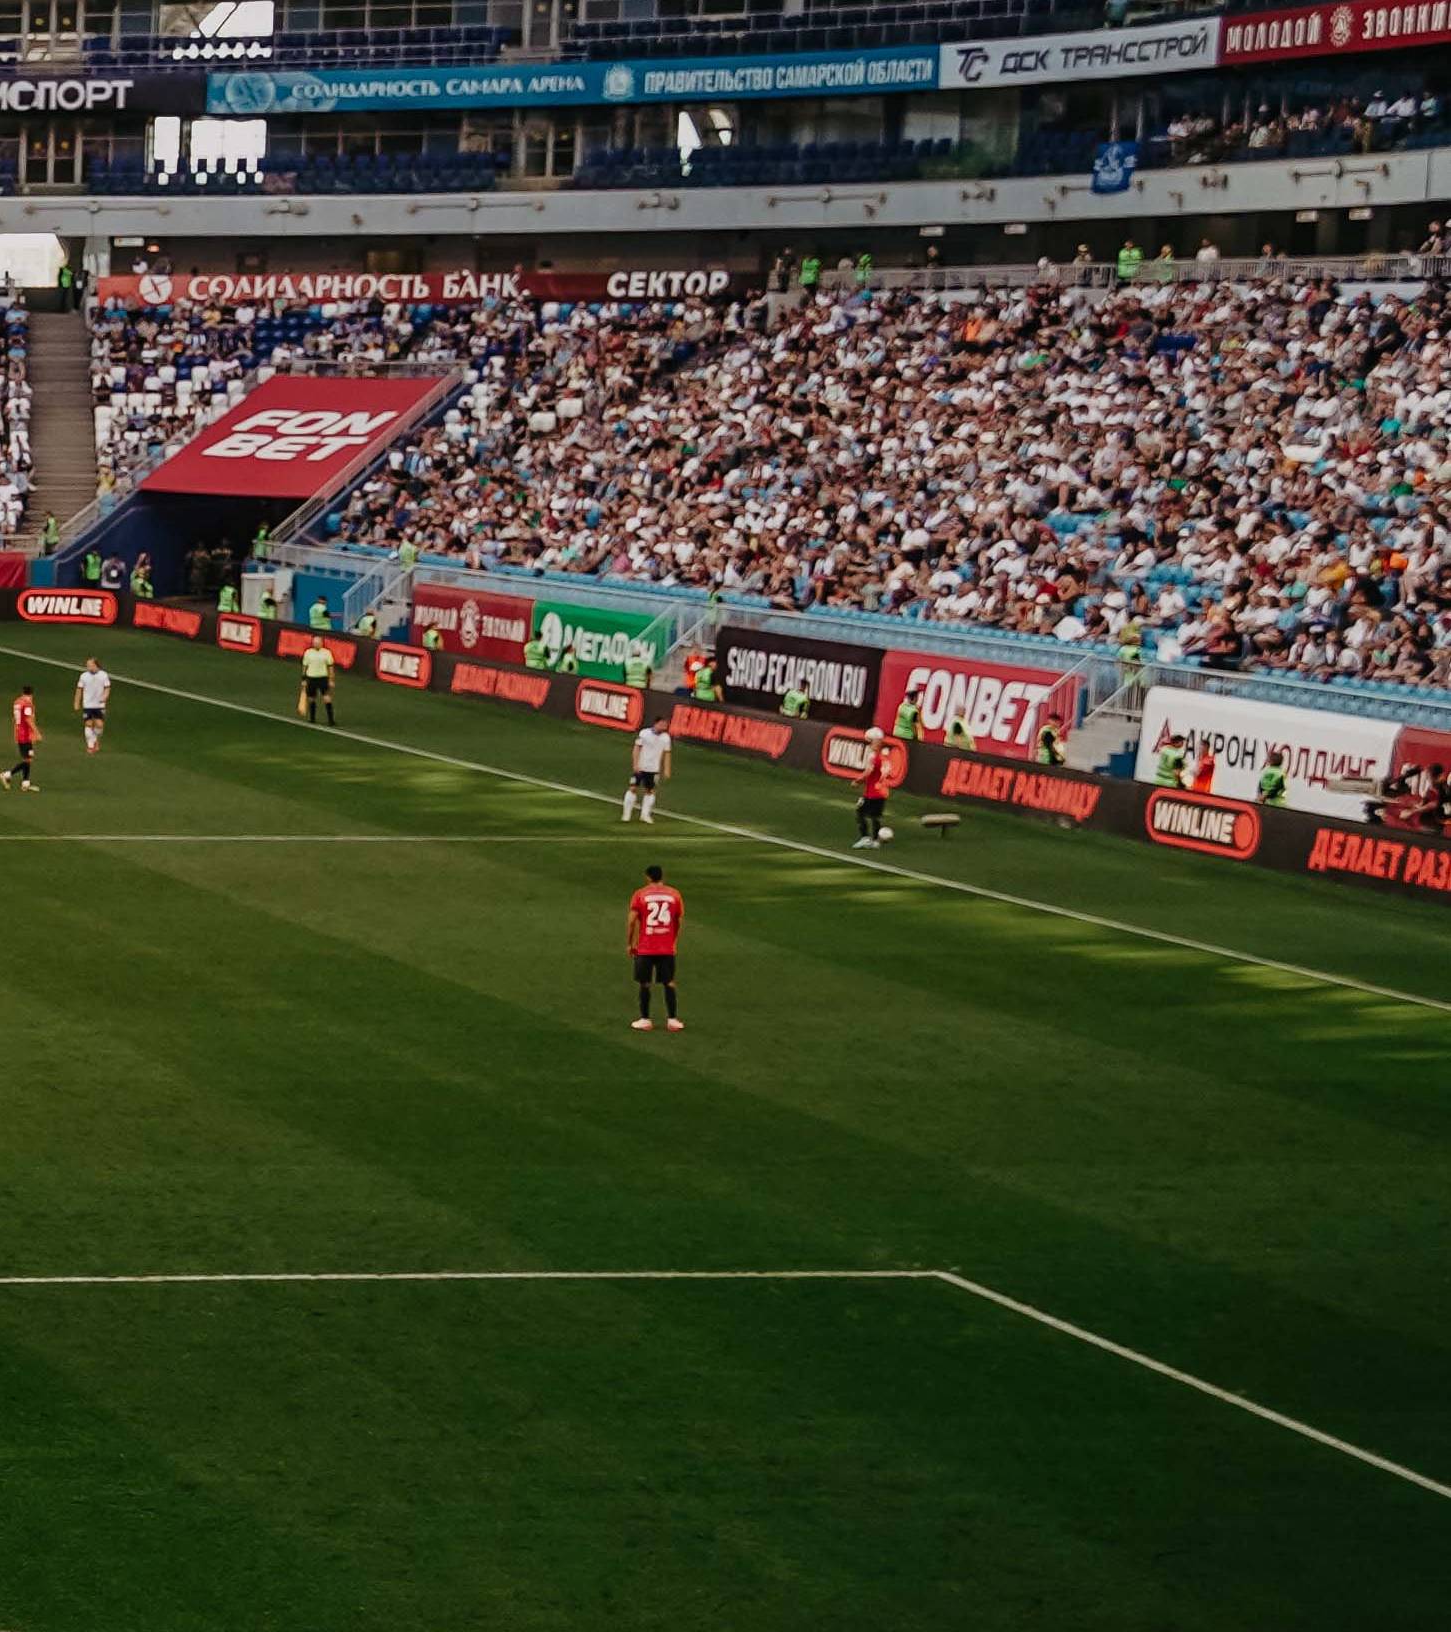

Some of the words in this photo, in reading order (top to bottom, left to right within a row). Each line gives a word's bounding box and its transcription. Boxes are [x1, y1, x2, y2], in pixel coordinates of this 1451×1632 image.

[1225, 10, 1322, 52] МОЛОДОЙ
[1361, 0, 1451, 39] ЗВОНКИ
[999, 47, 1049, 75] ДСК
[1060, 27, 1209, 68] ТРАНССТРОЙ
[292, 79, 441, 99] СОЛИДАРНОСТЬ
[445, 77, 523, 96] САМАРА
[527, 75, 585, 94] АРЕНА
[644, 64, 773, 92] ПРАВИТЕЛЬСТВО
[775, 58, 864, 88] САМАРСКОЙ
[866, 57, 933, 84] ОБЛАСТИ
[187, 273, 431, 303] СОЛИДАРНОСТЬ
[442, 271, 521, 299] БАНК
[607, 271, 730, 298] СЕКТОР
[231, 408, 399, 435] FON
[201, 433, 369, 461] BET
[941, 757, 1014, 806] ДЕЛАЕТ
[1013, 767, 1102, 820] РАЗНИЦУ
[1153, 800, 1235, 845] WINLINE
[1307, 827, 1407, 881] ДЕЛАЕТ
